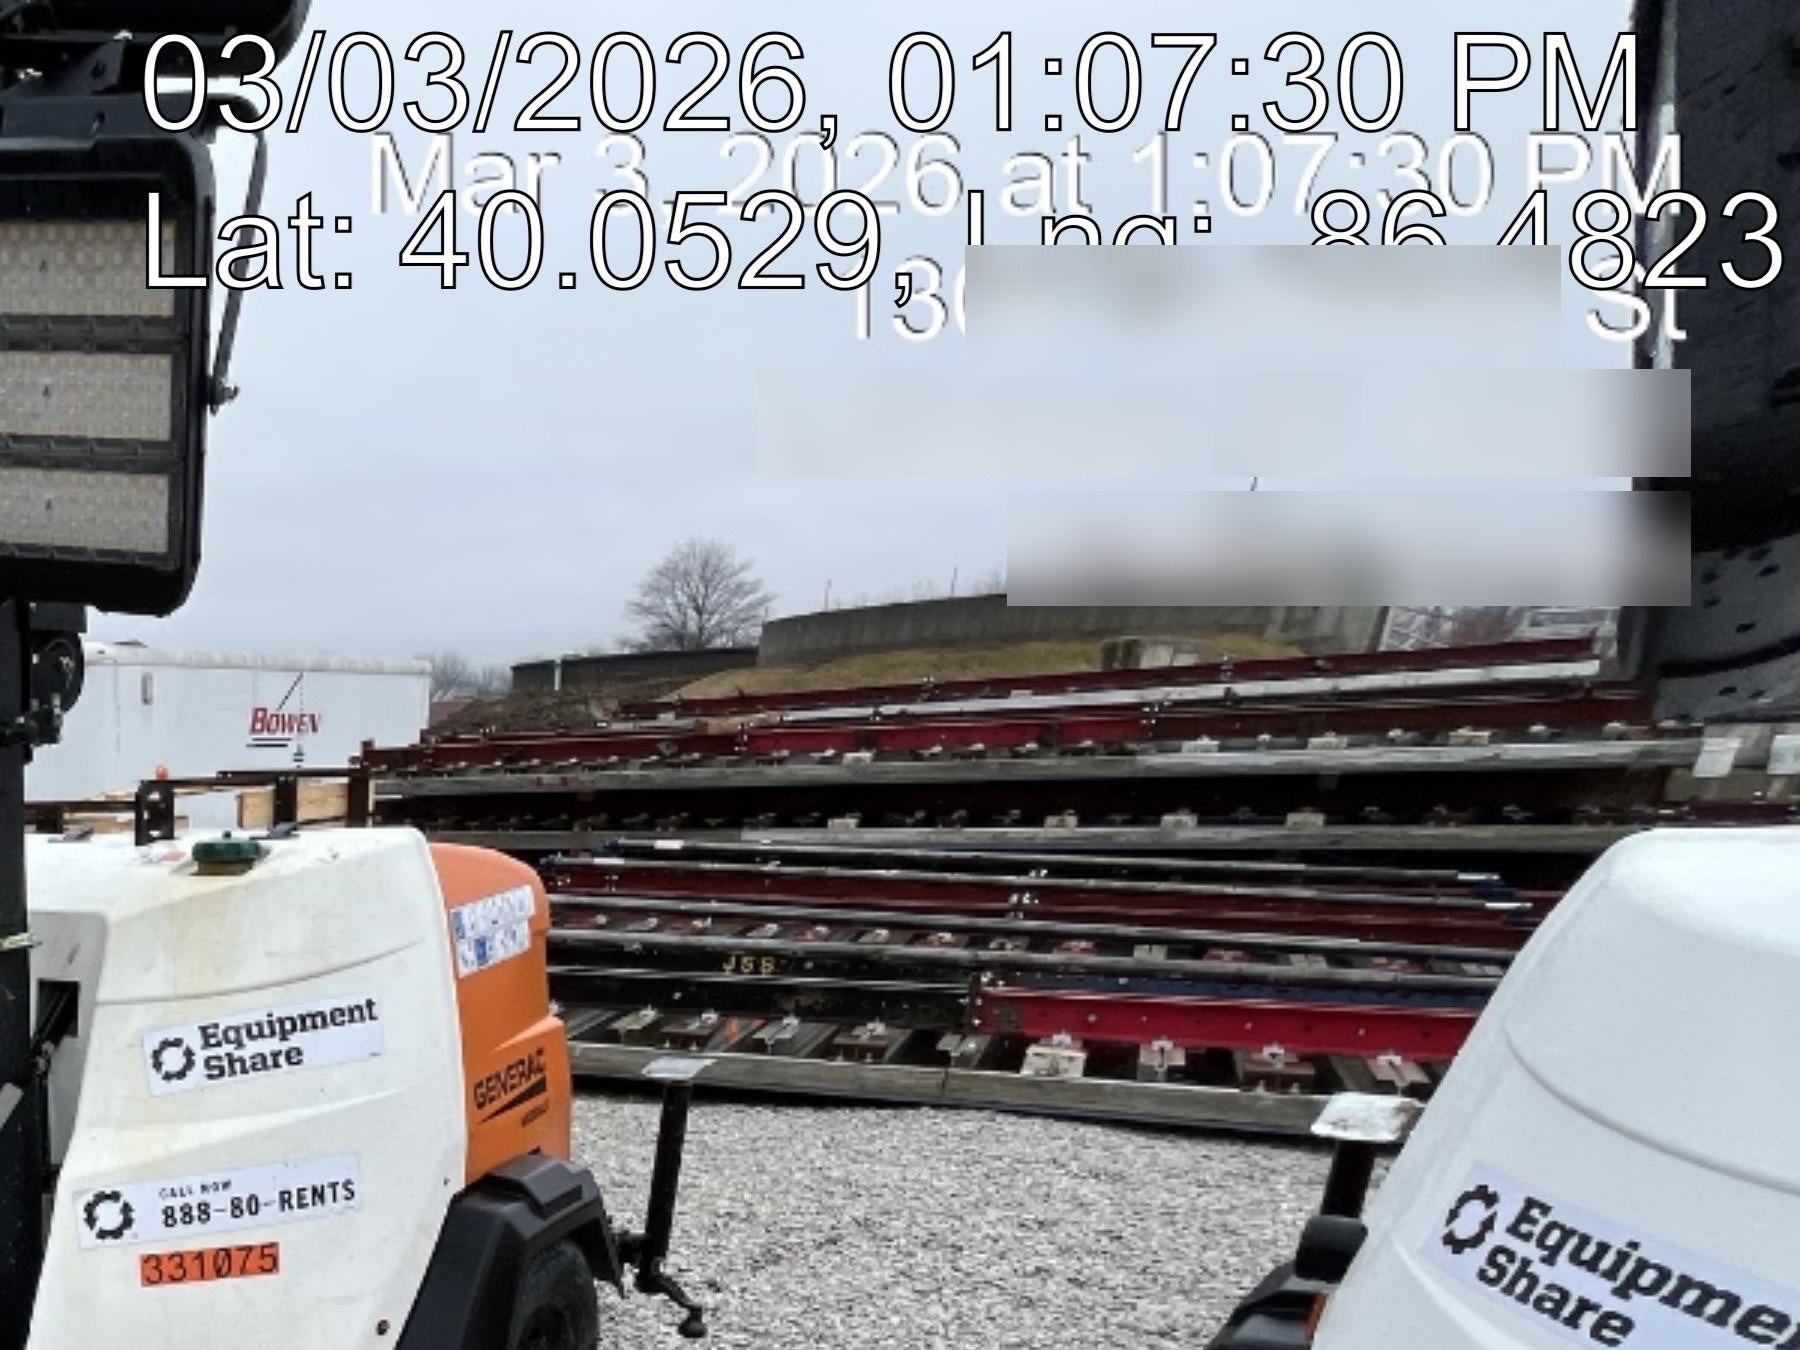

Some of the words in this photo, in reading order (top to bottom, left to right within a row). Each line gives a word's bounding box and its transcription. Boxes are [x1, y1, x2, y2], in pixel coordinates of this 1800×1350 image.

[197, 998, 379, 1051] Equipment
[202, 1045, 304, 1081] Share
[473, 1048, 546, 1111] GENERAC
[161, 1178, 356, 1228] 888-80-RENTS
[142, 1242, 279, 1286] 331075
[1476, 1244, 1635, 1348] Share
